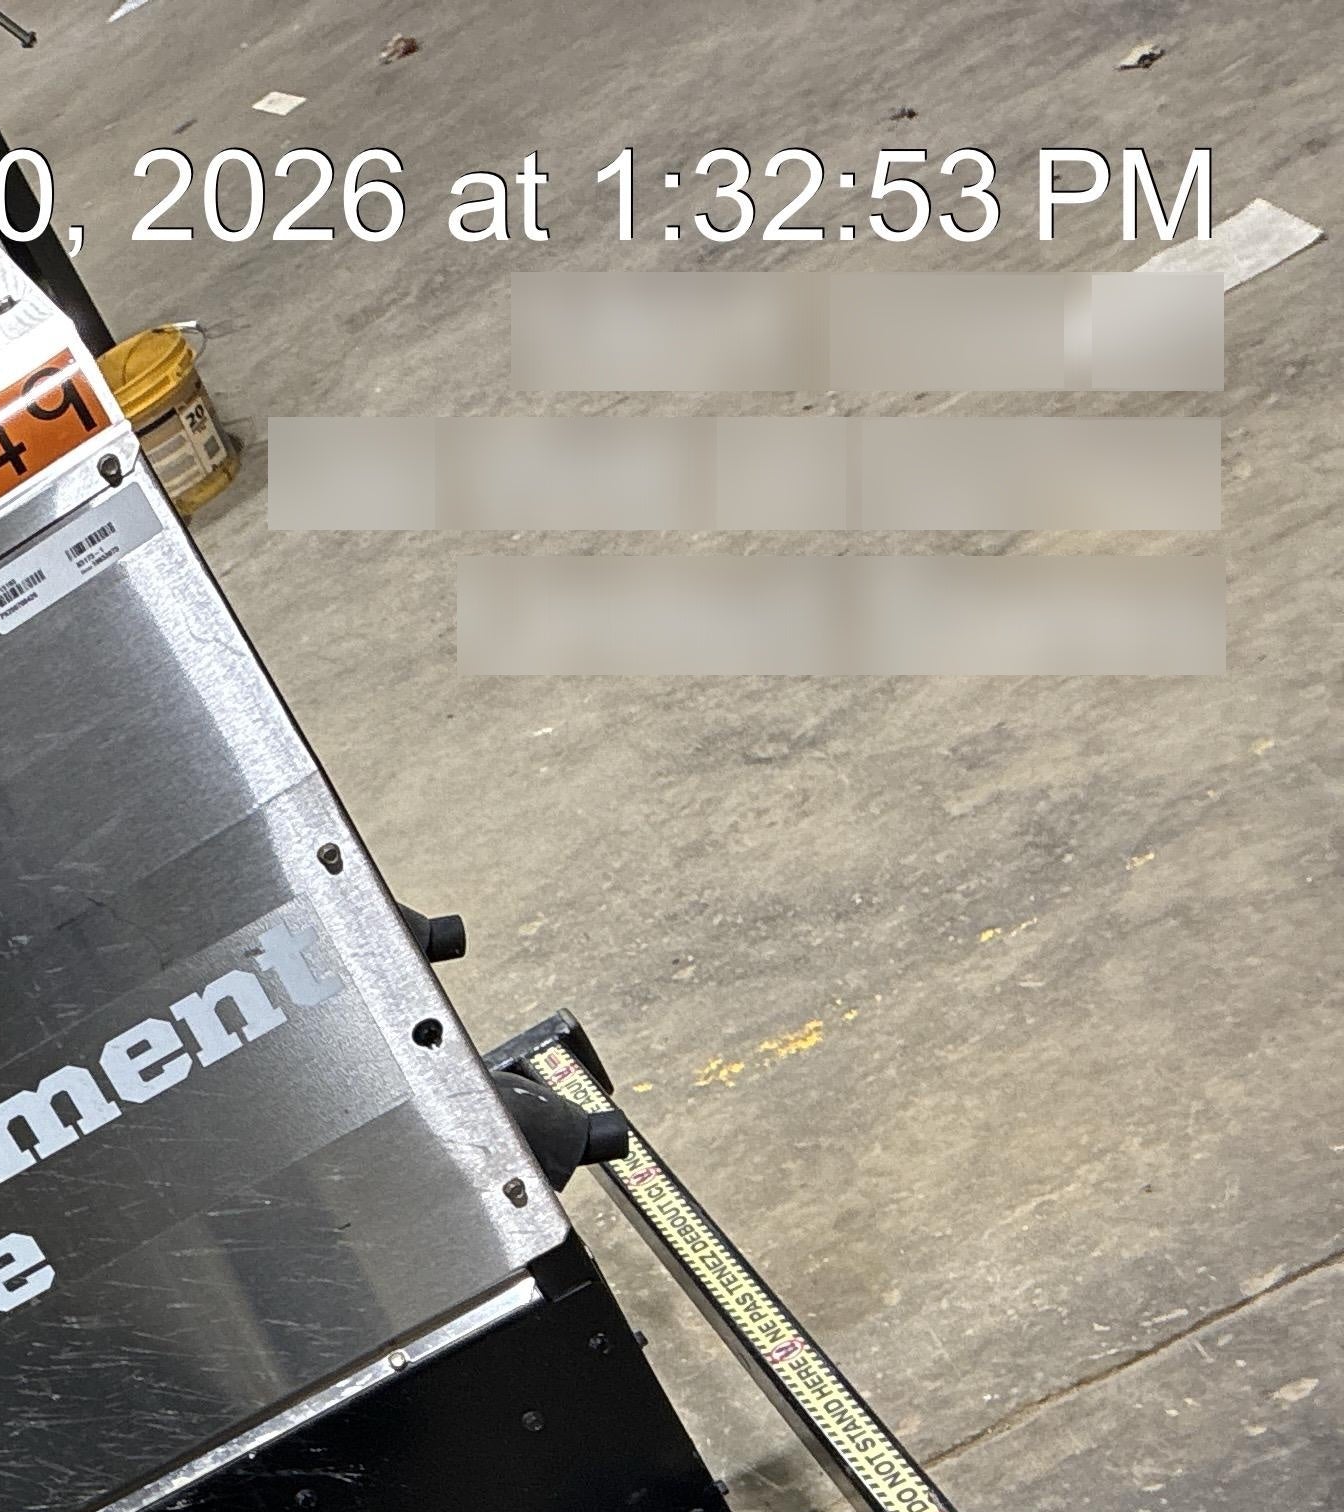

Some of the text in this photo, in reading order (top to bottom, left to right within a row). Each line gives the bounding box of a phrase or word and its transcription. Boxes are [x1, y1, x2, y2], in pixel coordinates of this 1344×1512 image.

[644, 1182, 783, 1345] NE PAS TENEZ DEBOUT ICI
[790, 1354, 833, 1401] HERE
[823, 1396, 877, 1455] STAND
[866, 1448, 906, 1491] NOT
